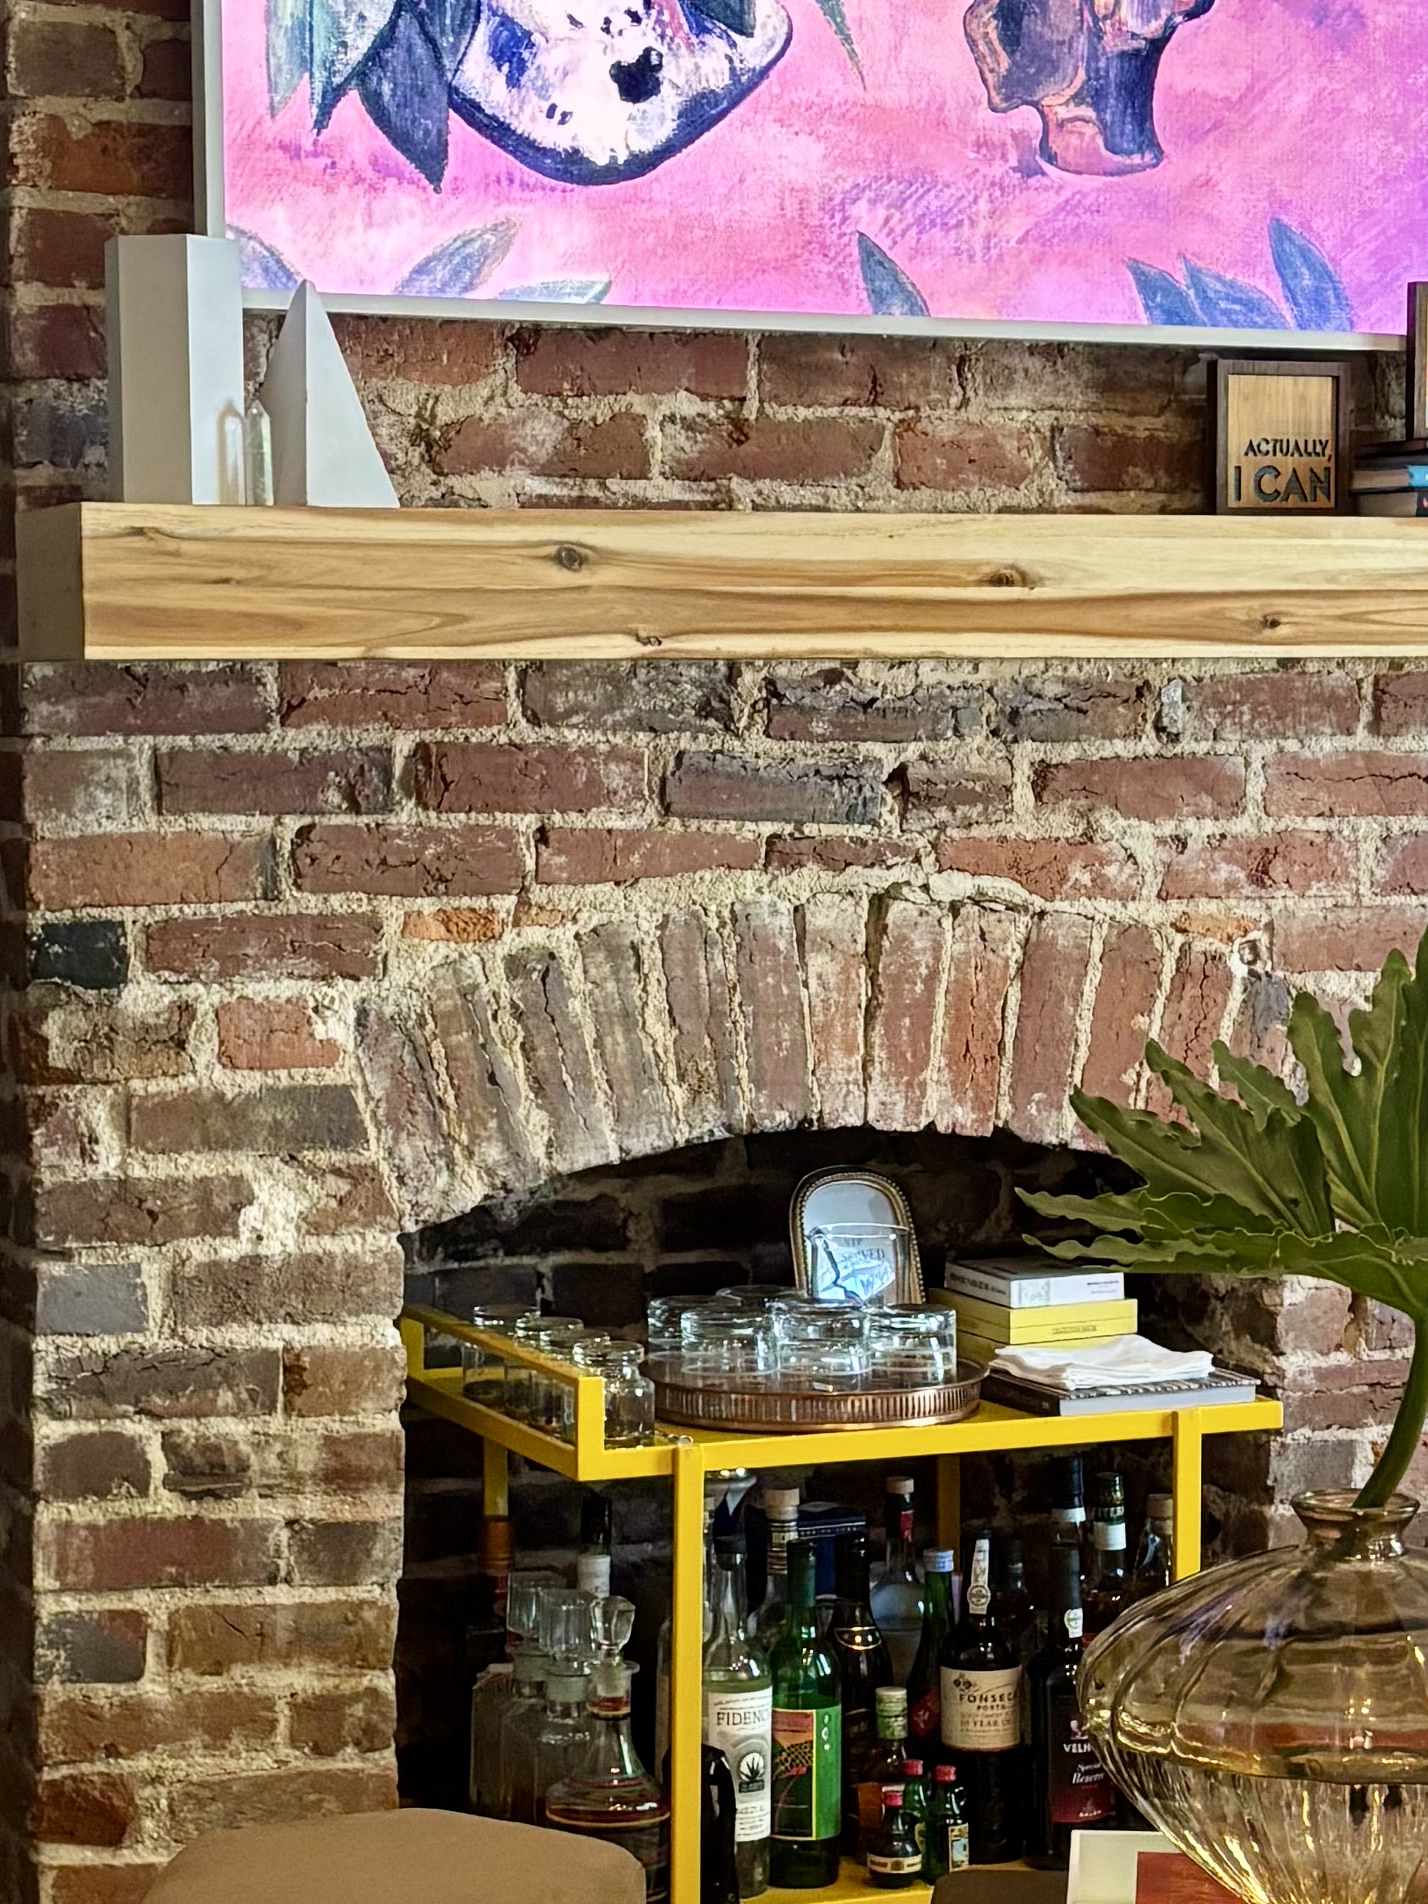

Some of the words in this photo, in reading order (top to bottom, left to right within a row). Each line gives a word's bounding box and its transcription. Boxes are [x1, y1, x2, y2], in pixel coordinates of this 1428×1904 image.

[1244, 437, 1332, 463] ACTUALLY,
[1234, 465, 1241, 502] I
[1254, 465, 1331, 503] CAN
[959, 1693, 1019, 1704] FONSEC
